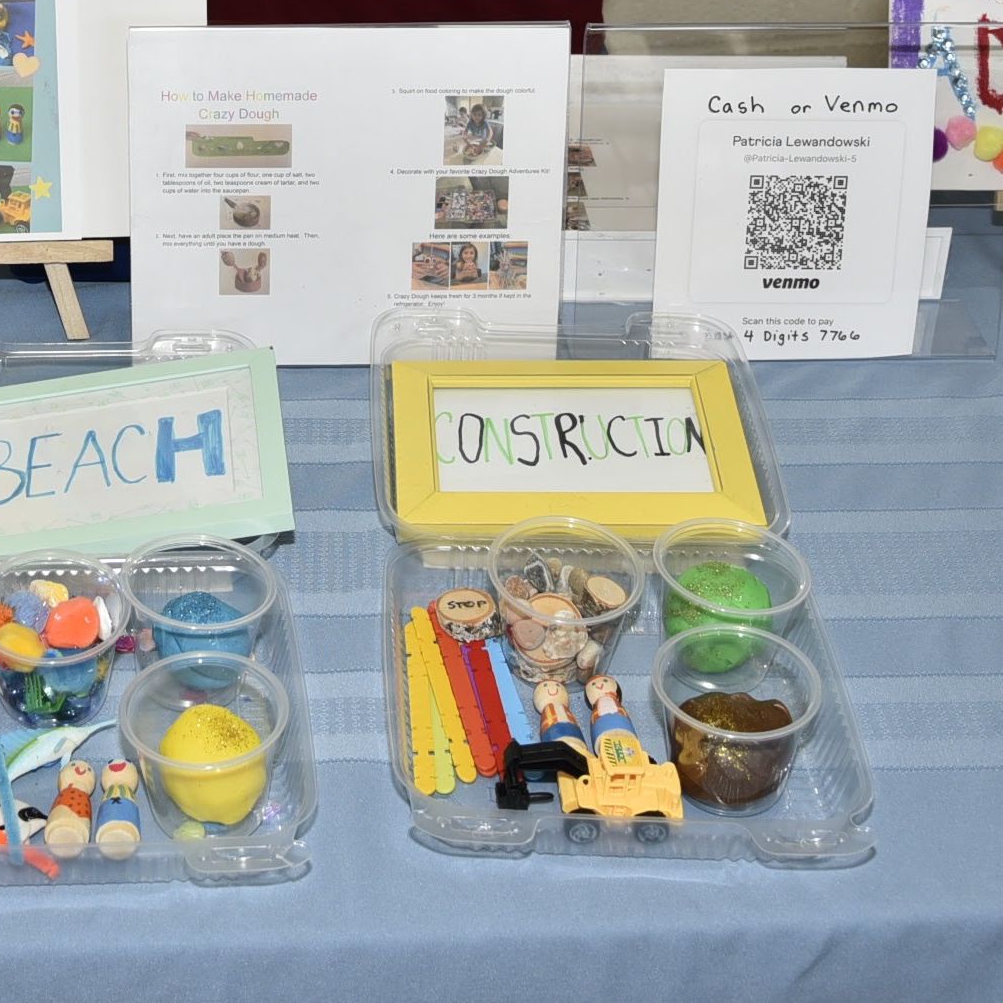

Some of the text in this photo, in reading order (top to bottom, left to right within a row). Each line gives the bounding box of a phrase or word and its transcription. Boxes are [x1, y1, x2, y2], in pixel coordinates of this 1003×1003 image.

[161, 90, 317, 102] How to Make Homemade
[708, 95, 898, 114] Cash or Venmo
[198, 108, 279, 122] Crazy Dough
[732, 136, 870, 147] Patricia Lewandowski
[744, 154, 857, 164] @Patricia-Lewandowski-5
[762, 278, 820, 289] venmo
[742, 317, 834, 328] Scan this code to pay
[744, 330, 754, 342] 4
[764, 330, 809, 346] Digits
[820, 330, 860, 342] 7766
[435, 411, 706, 467] CONSTRUCTION
[448, 601, 487, 609] STOP
